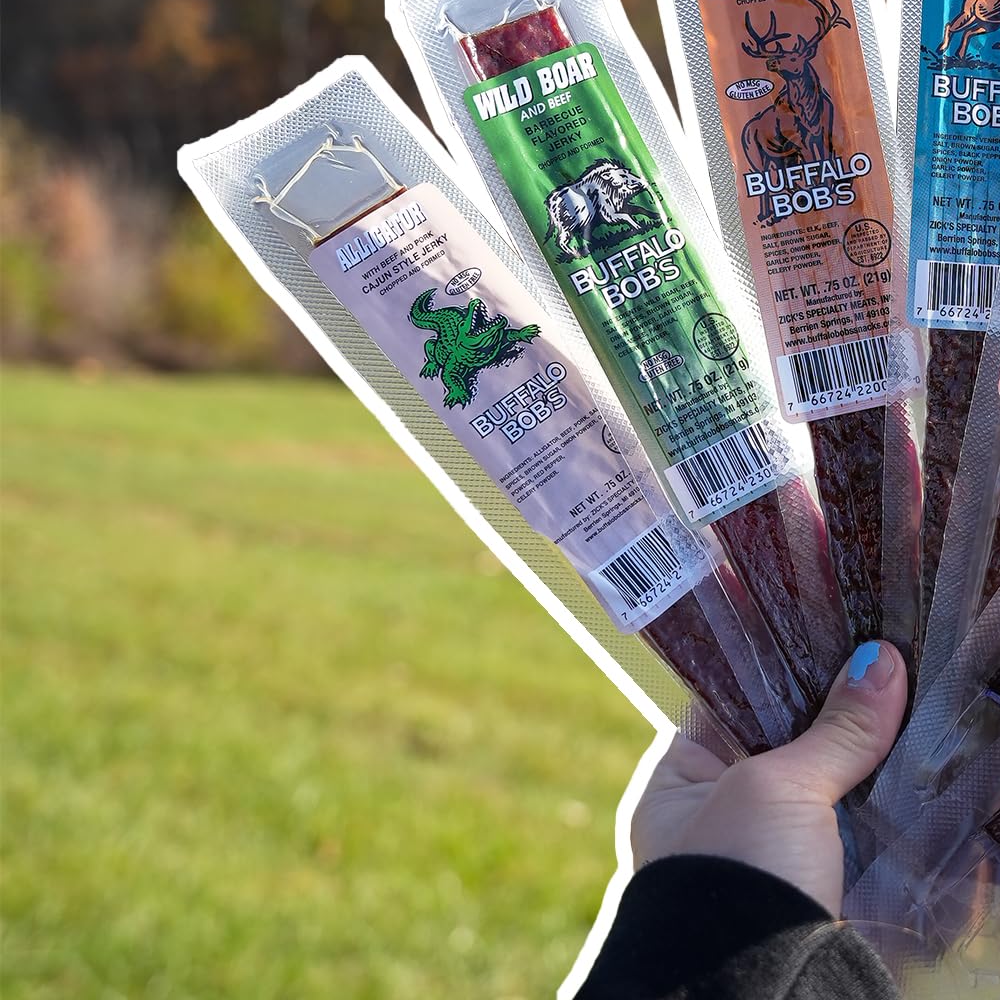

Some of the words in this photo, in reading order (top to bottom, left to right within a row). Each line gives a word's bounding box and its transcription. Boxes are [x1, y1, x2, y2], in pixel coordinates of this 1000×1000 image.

[472, 74, 537, 122] WILD
[533, 49, 599, 97] BOAR
[728, 86, 754, 101] GLUTEN
[753, 84, 771, 96] FREE
[735, 80, 745, 90] NO
[745, 77, 761, 89] MSG
[517, 101, 547, 121] AND
[546, 91, 573, 109] BEEF
[523, 104, 583, 135] BARBECUE
[530, 116, 587, 145] FLAVORED
[546, 130, 583, 152] JERKY
[742, 147, 873, 200] BUFFALO
[770, 178, 857, 219] BOB'S
[932, 196, 951, 206] NET
[978, 200, 994, 210] .75
[331, 198, 428, 273] ALLIGATOR
[361, 265, 380, 280] WITH
[379, 252, 399, 268] BEEF
[398, 242, 414, 256] AND
[413, 230, 434, 246] PORK
[361, 270, 393, 294] CAJUN
[391, 251, 420, 274] STYLE
[419, 232, 450, 256] JERKY
[378, 273, 408, 295] CHOPPED
[407, 265, 421, 276] AND
[420, 249, 445, 268] FORMED
[567, 223, 689, 296] BUFFALO
[598, 254, 682, 310] BOB'S
[774, 287, 797, 303] NET.
[799, 282, 820, 297] WT.
[822, 279, 840, 293] .75
[841, 274, 859, 288] OZ.
[862, 268, 891, 287] (21g)
[778, 311, 804, 324] ZICK'S
[805, 302, 848, 319] SPECIALTY
[789, 321, 818, 335] Berrien
[819, 314, 853, 330] Springs,
[853, 311, 864, 320] MI
[865, 306, 889, 318] 49103
[939, 306, 979, 318] 66724
[682, 379, 701, 396] .75
[701, 369, 722, 386] OZ.
[721, 356, 750, 378] (21g)
[468, 357, 570, 439] BUFFALO
[497, 384, 569, 445] BOB'S
[787, 402, 794, 410] 7
[810, 388, 852, 406] 66724
[569, 501, 587, 518] NET
[584, 488, 603, 505] WT.
[602, 478, 616, 492] .75
[614, 467, 630, 483] OZ.
[637, 577, 672, 608] 66724
